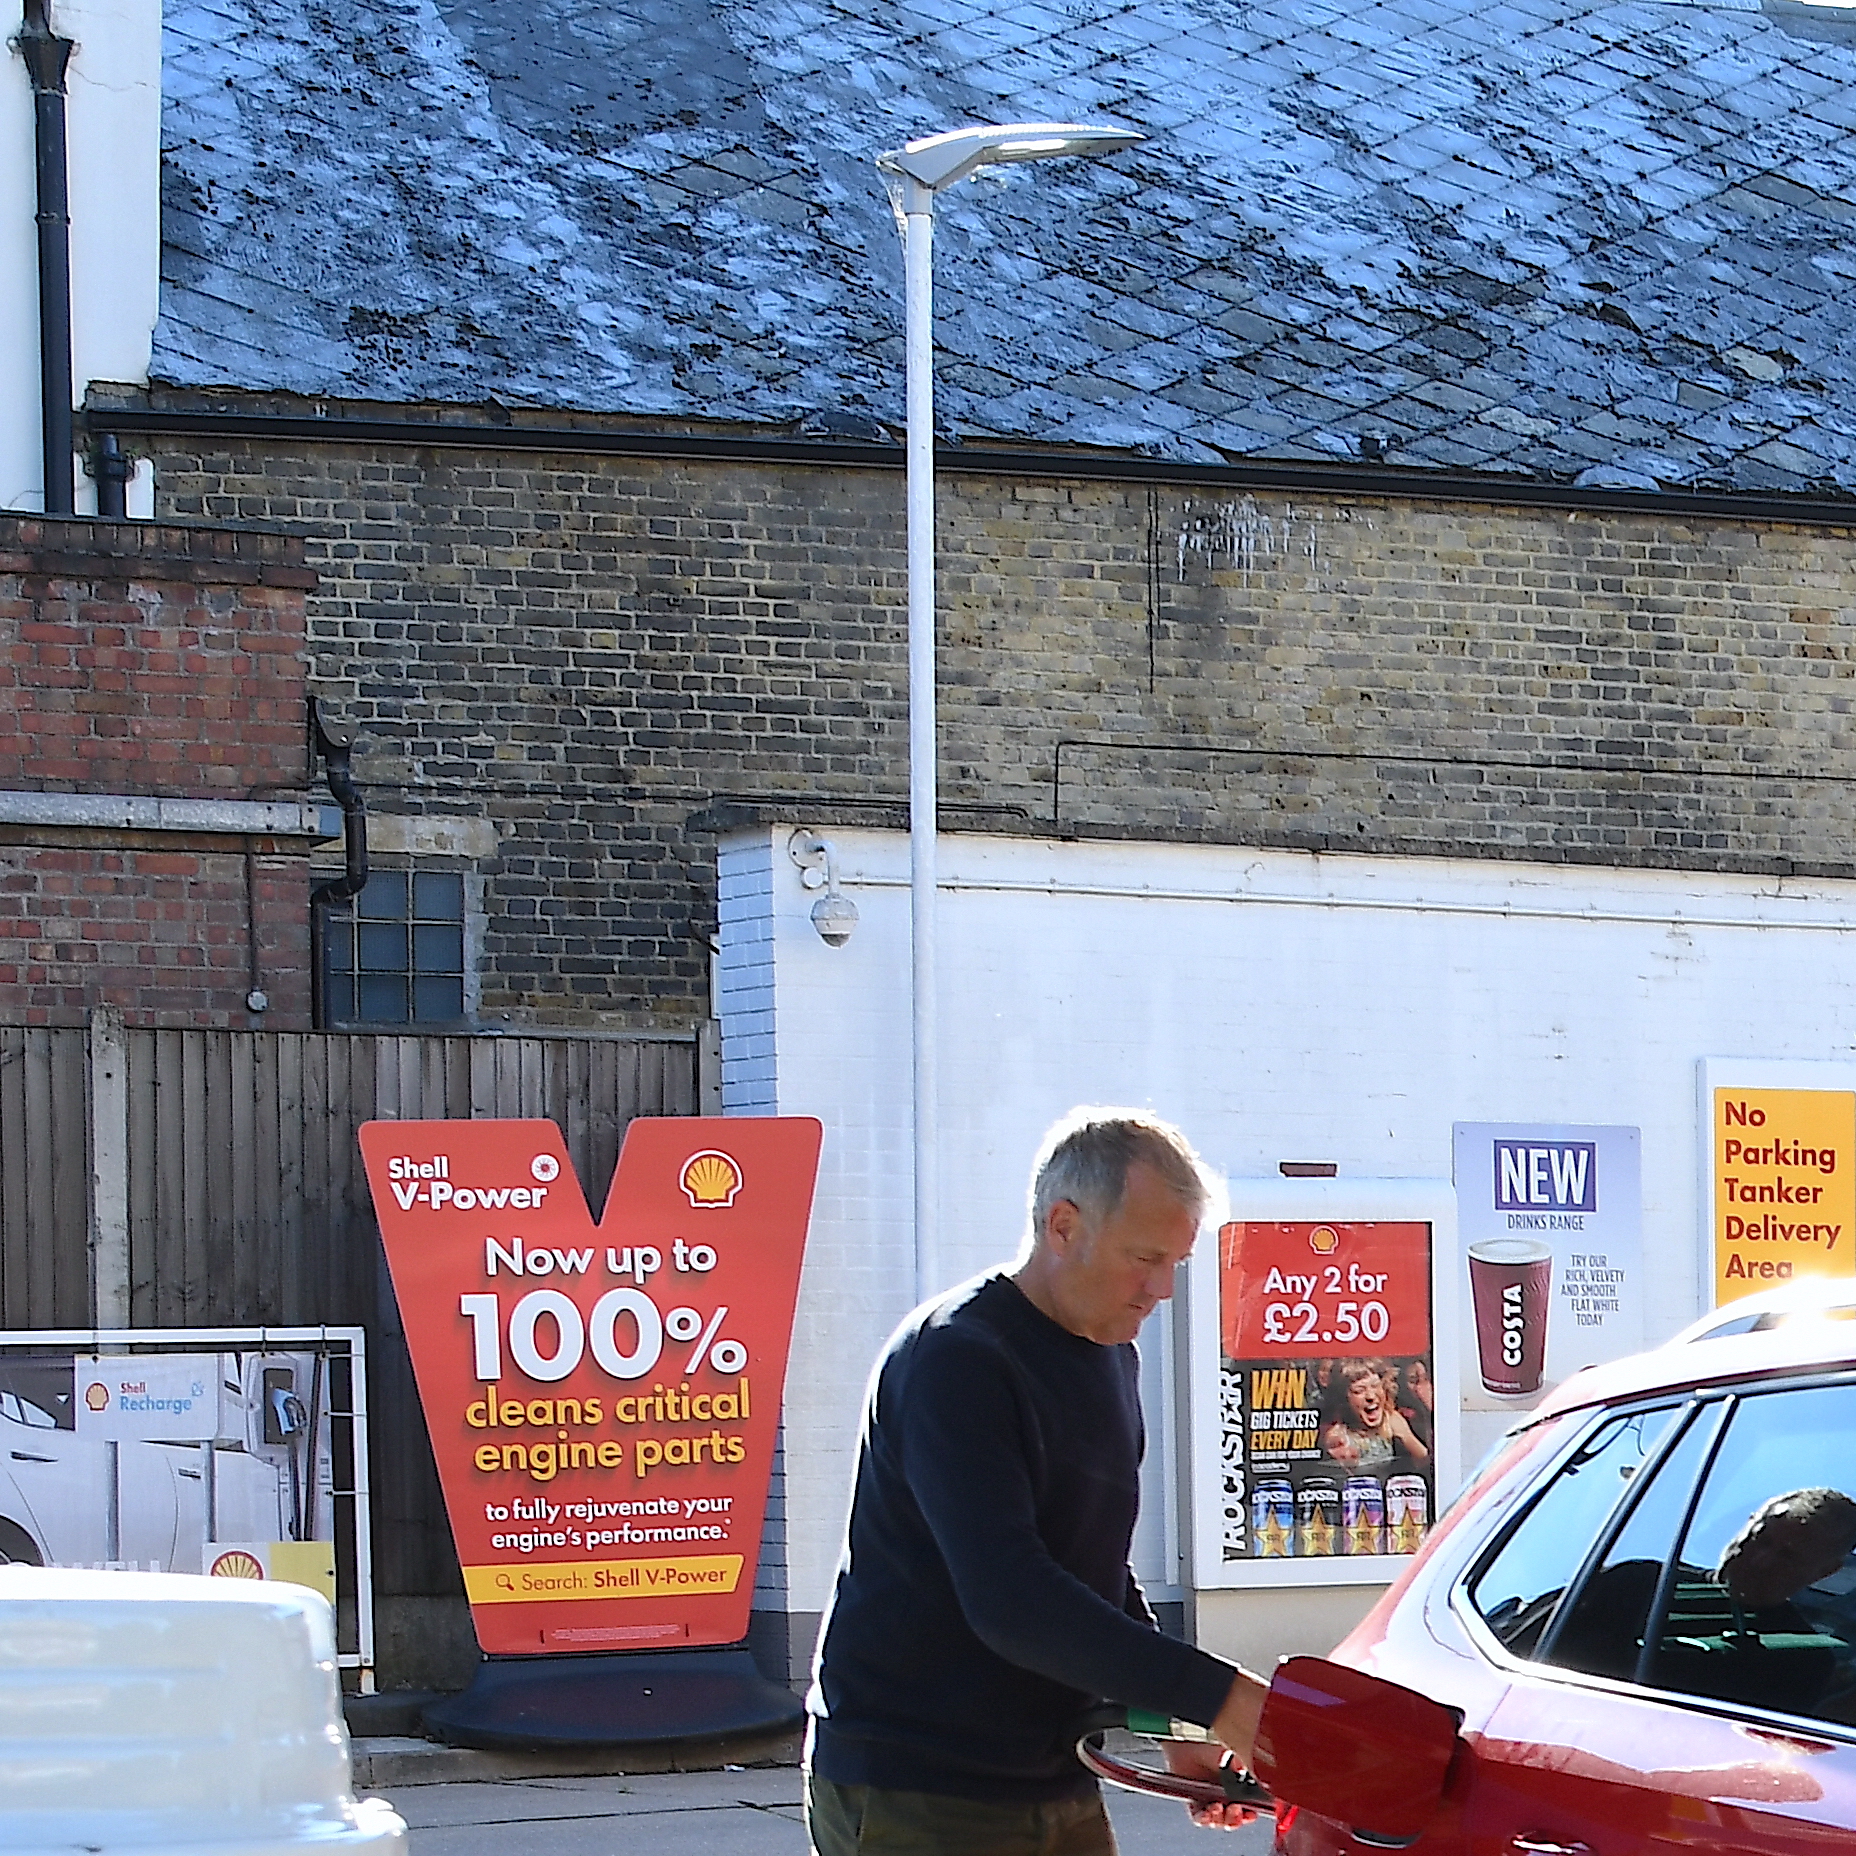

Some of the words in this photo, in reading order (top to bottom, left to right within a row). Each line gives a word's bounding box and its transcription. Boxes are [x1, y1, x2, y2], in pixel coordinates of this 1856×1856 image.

[1724, 1101, 1766, 1128] No
[388, 1156, 449, 1180] Shell
[1724, 1140, 1836, 1173] Parking
[1500, 1145, 1590, 1206] NEW
[392, 1182, 547, 1210] V-Power
[1724, 1178, 1824, 1204] Tanker
[1507, 1214, 1547, 1230] DRINKS
[1550, 1215, 1584, 1231] RANGE
[1724, 1214, 1841, 1250] Delivery
[486, 1237, 593, 1276] Now
[606, 1247, 661, 1283] up
[673, 1240, 717, 1273] to
[1571, 1255, 1586, 1267] TRY
[1589, 1255, 1607, 1267] OUR
[1724, 1253, 1793, 1279] Area
[1263, 1266, 1318, 1301] Any
[1324, 1265, 1342, 1293] 2
[1347, 1262, 1389, 1293] for
[1565, 1270, 1588, 1283] RICH,
[1590, 1270, 1624, 1282] VELVETY
[1561, 1285, 1579, 1297] AND
[1581, 1285, 1616, 1297] SMOOTH
[1571, 1299, 1590, 1311] FLAT
[1592, 1300, 1619, 1311] WHITE
[1262, 1302, 1390, 1343] £2.50
[1503, 1284, 1524, 1366] COSTA
[1576, 1314, 1603, 1326] TODAY
[461, 1288, 748, 1382] 100%
[120, 1382, 146, 1395] Shell
[1251, 1369, 1306, 1409] WIN
[119, 1395, 192, 1415] Recharge
[465, 1385, 603, 1428] cleans
[615, 1378, 750, 1423] critical
[1251, 1411, 1271, 1430] GIG
[1273, 1410, 1319, 1429] TICKETS
[1251, 1431, 1292, 1450] EVERY
[1292, 1429, 1319, 1449] DAY
[474, 1431, 623, 1481] engine
[636, 1430, 745, 1476] parts
[485, 1502, 508, 1521] to
[512, 1497, 560, 1524] fully
[565, 1496, 679, 1522] rejuvenate
[683, 1497, 732, 1519] your
[491, 1526, 581, 1552] engine's
[522, 1573, 588, 1591] Search:
[594, 1568, 639, 1588] Shell
[646, 1566, 727, 1586] V-Power
